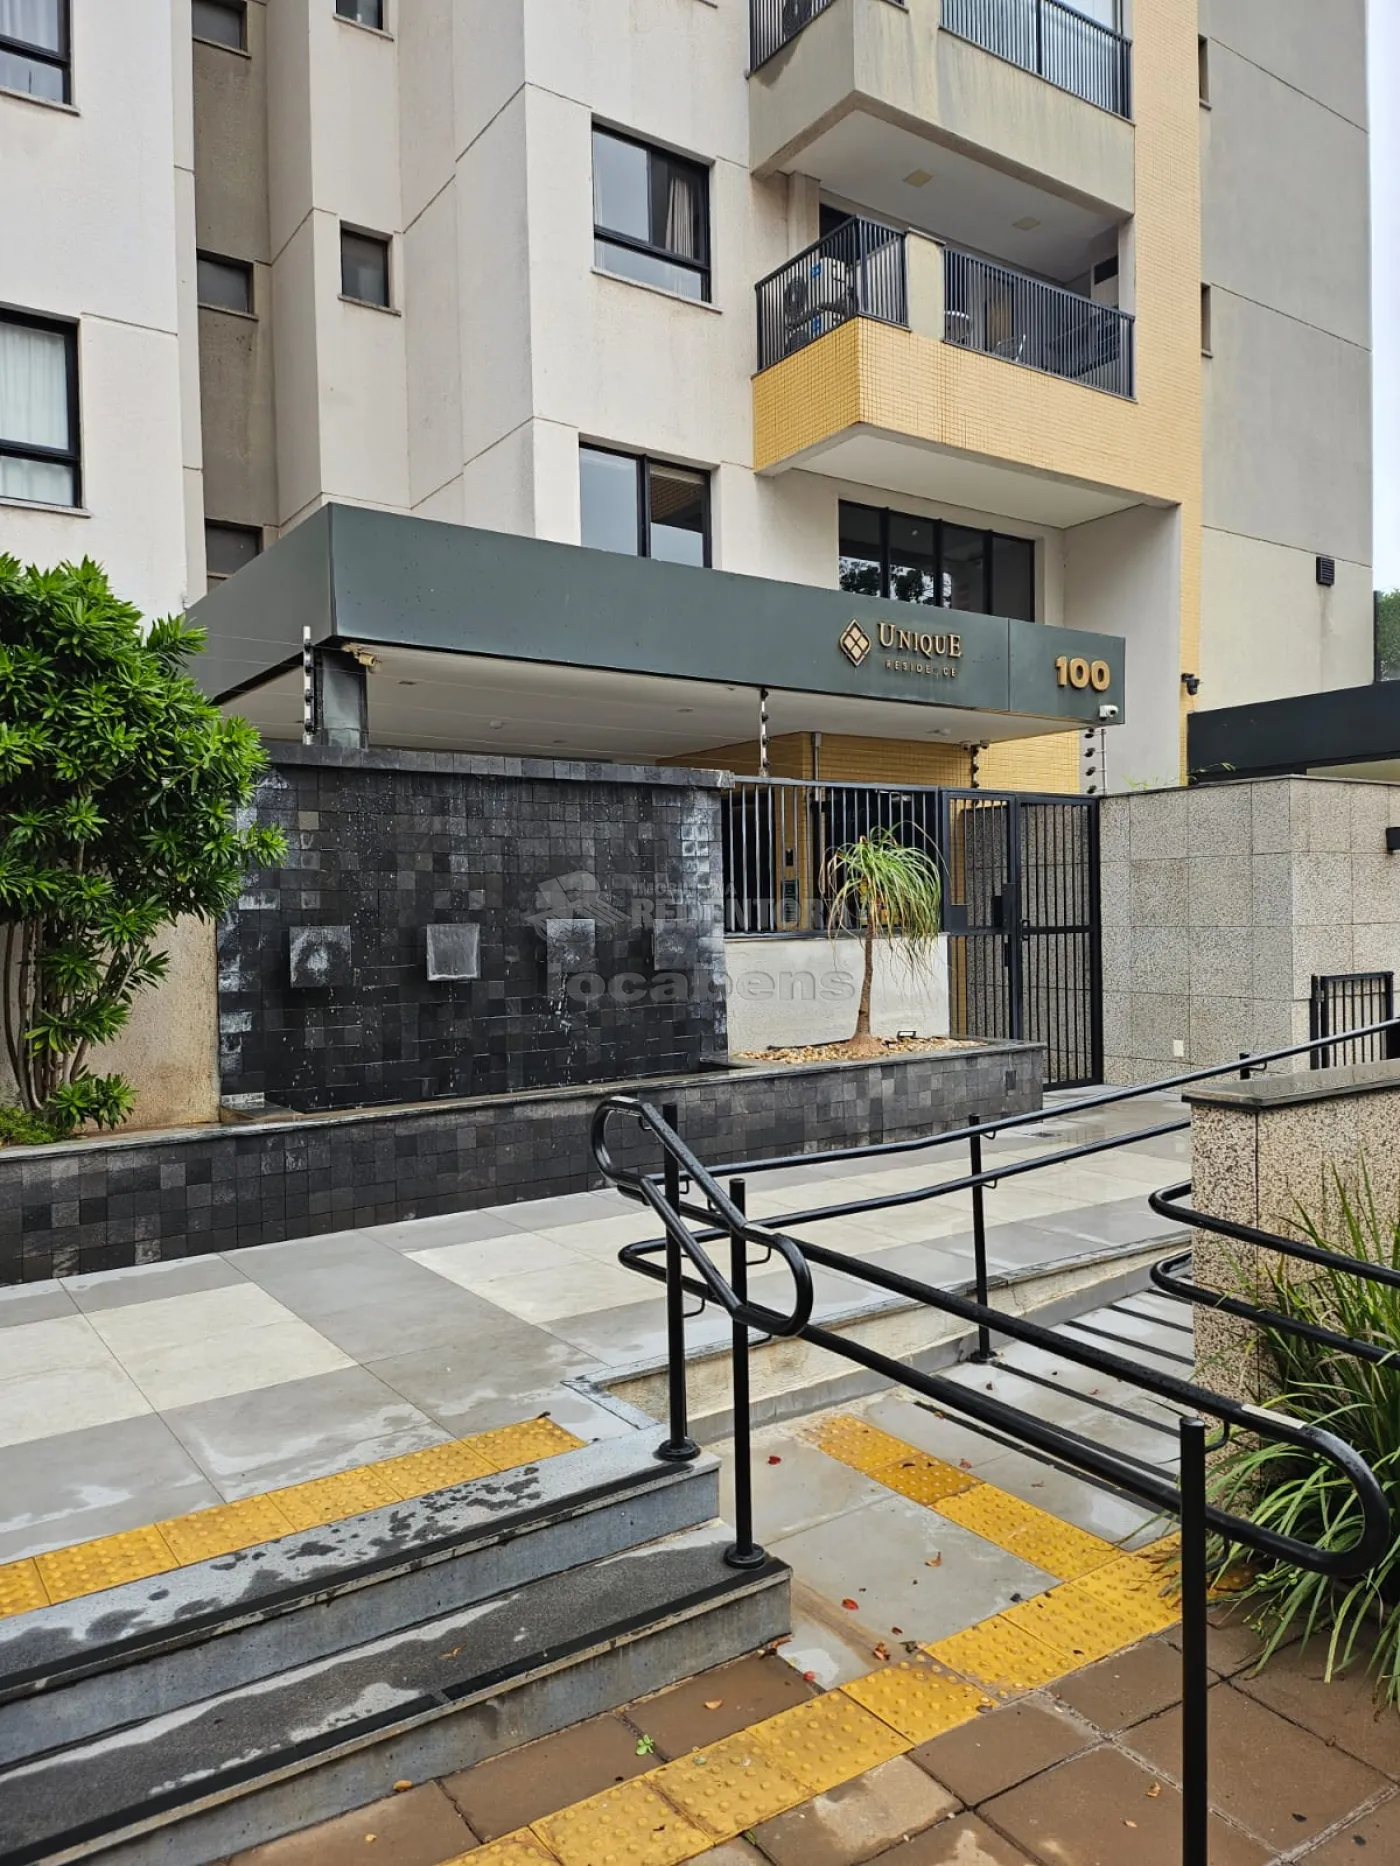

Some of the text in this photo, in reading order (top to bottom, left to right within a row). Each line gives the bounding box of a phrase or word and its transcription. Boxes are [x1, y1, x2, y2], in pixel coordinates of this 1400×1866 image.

[877, 622, 962, 659] UNIQUE
[885, 659, 957, 677] RESIDECE
[1056, 656, 1111, 692] 100
